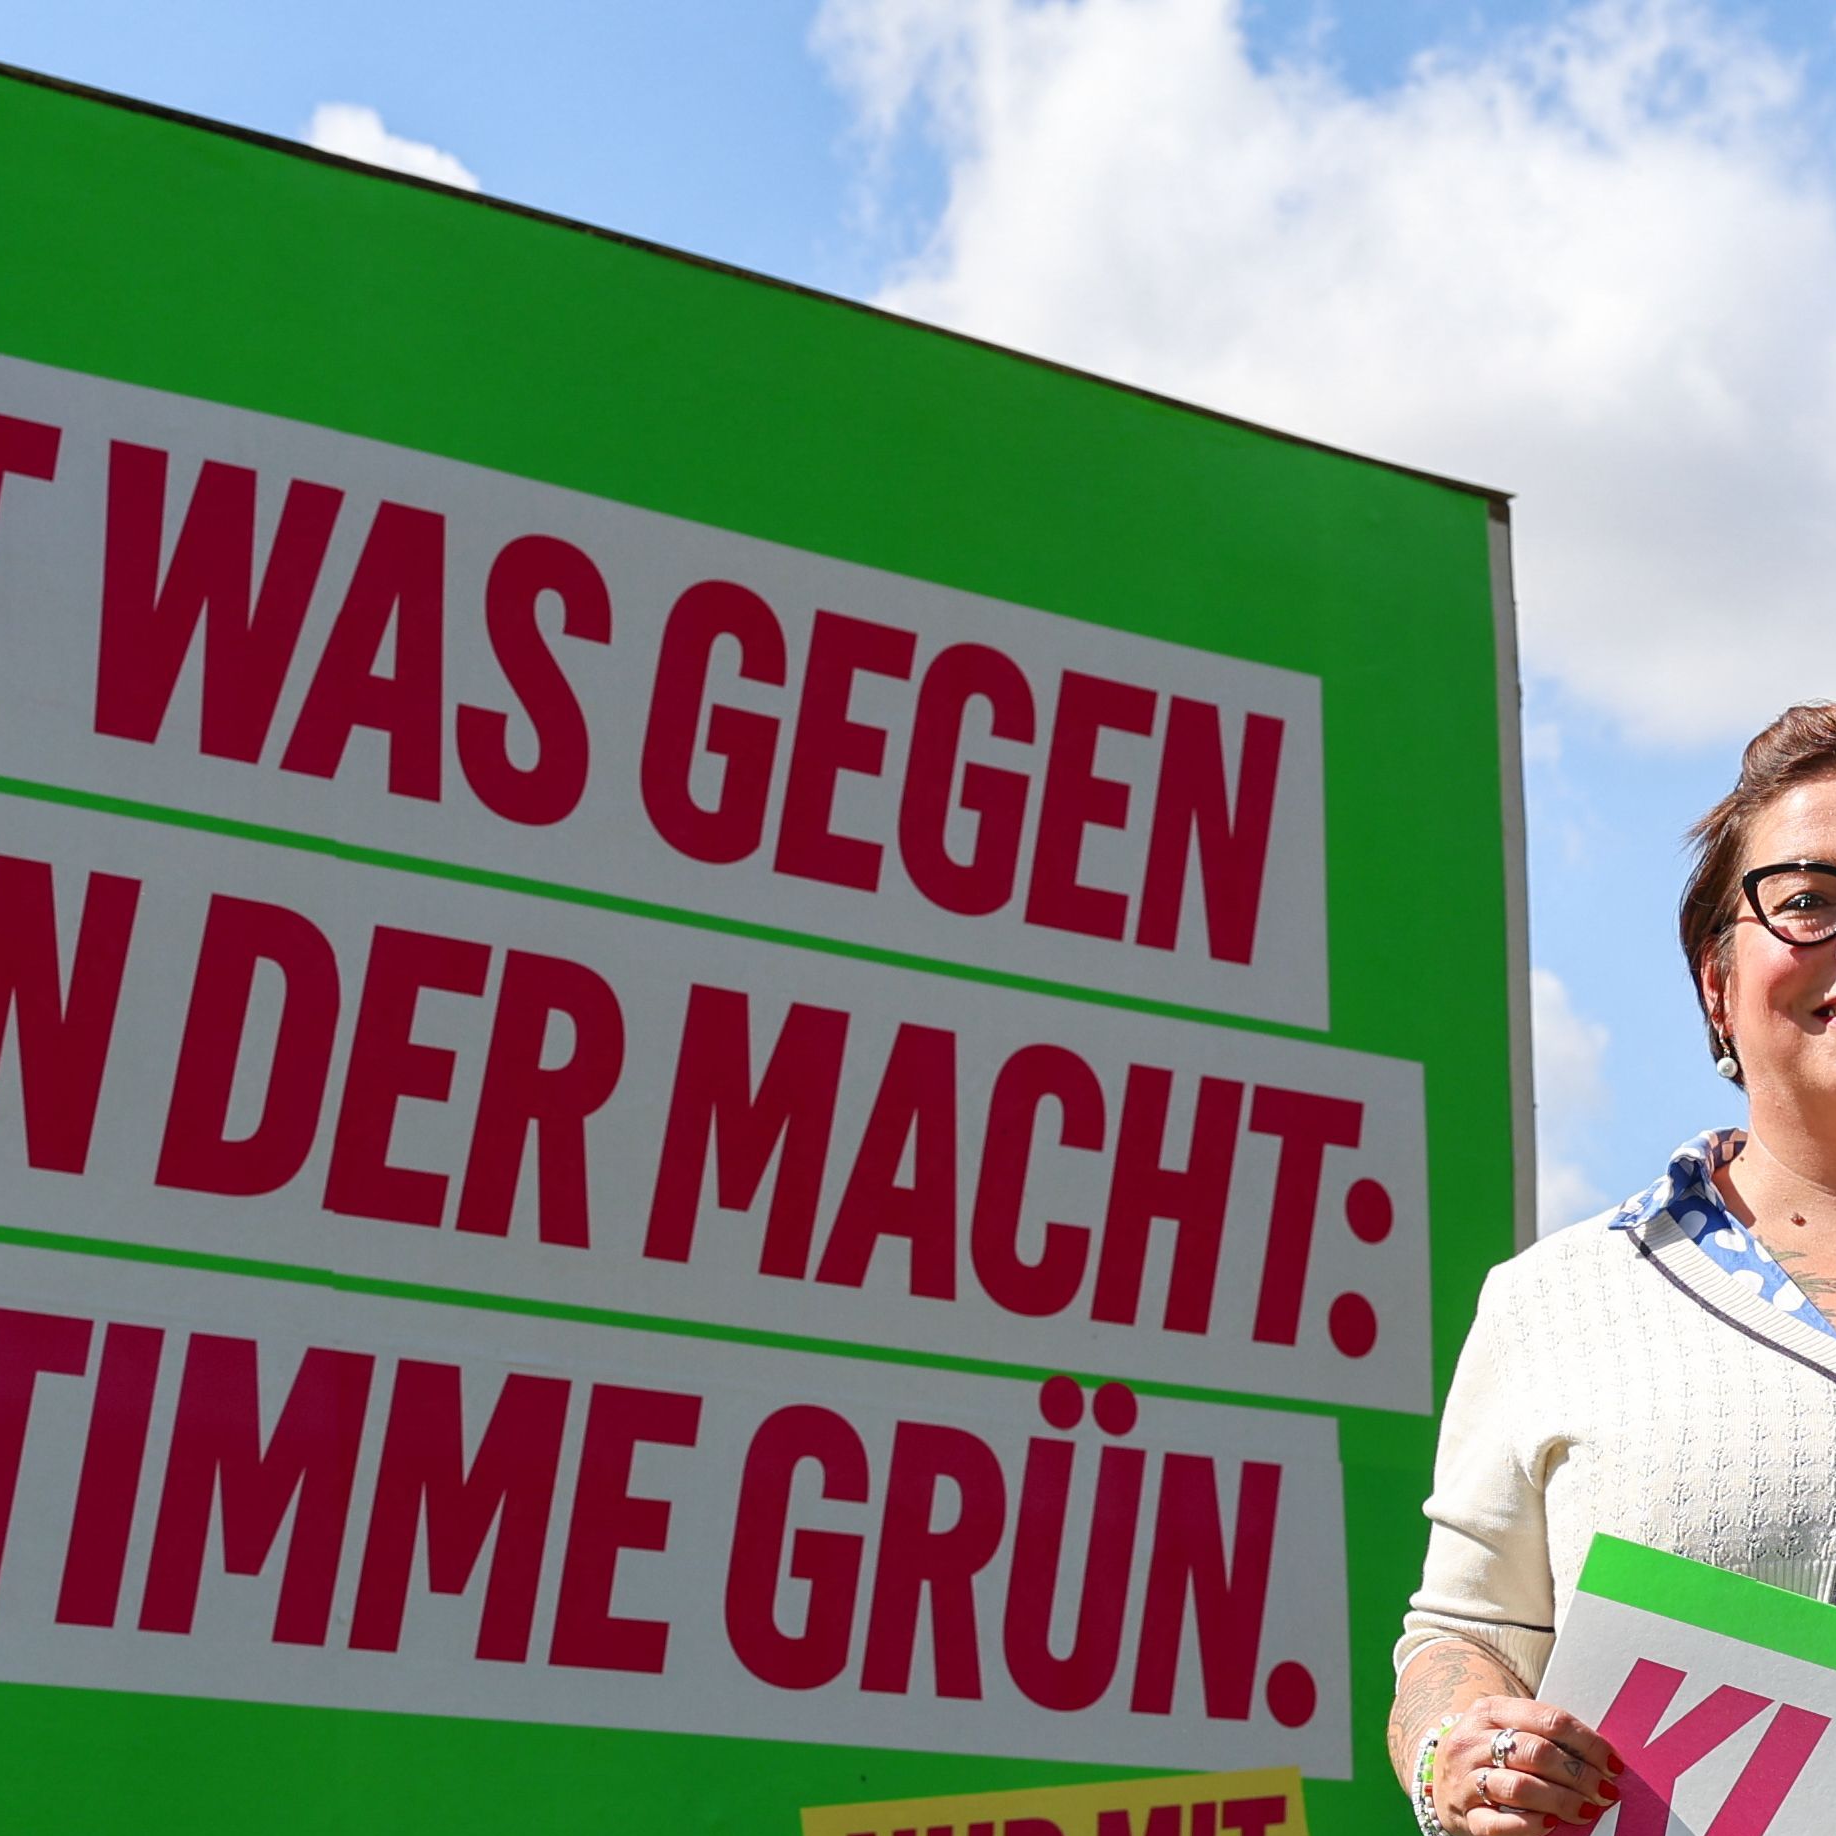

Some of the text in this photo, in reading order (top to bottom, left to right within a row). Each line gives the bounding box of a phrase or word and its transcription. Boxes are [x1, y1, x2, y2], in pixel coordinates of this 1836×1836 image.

[94, 438, 612, 827] WAS
[640, 579, 1286, 966] GEGEN
[154, 893, 626, 1250] DER
[643, 983, 1394, 1359] MACHT:
[724, 1374, 1318, 1729] GRÜN.
